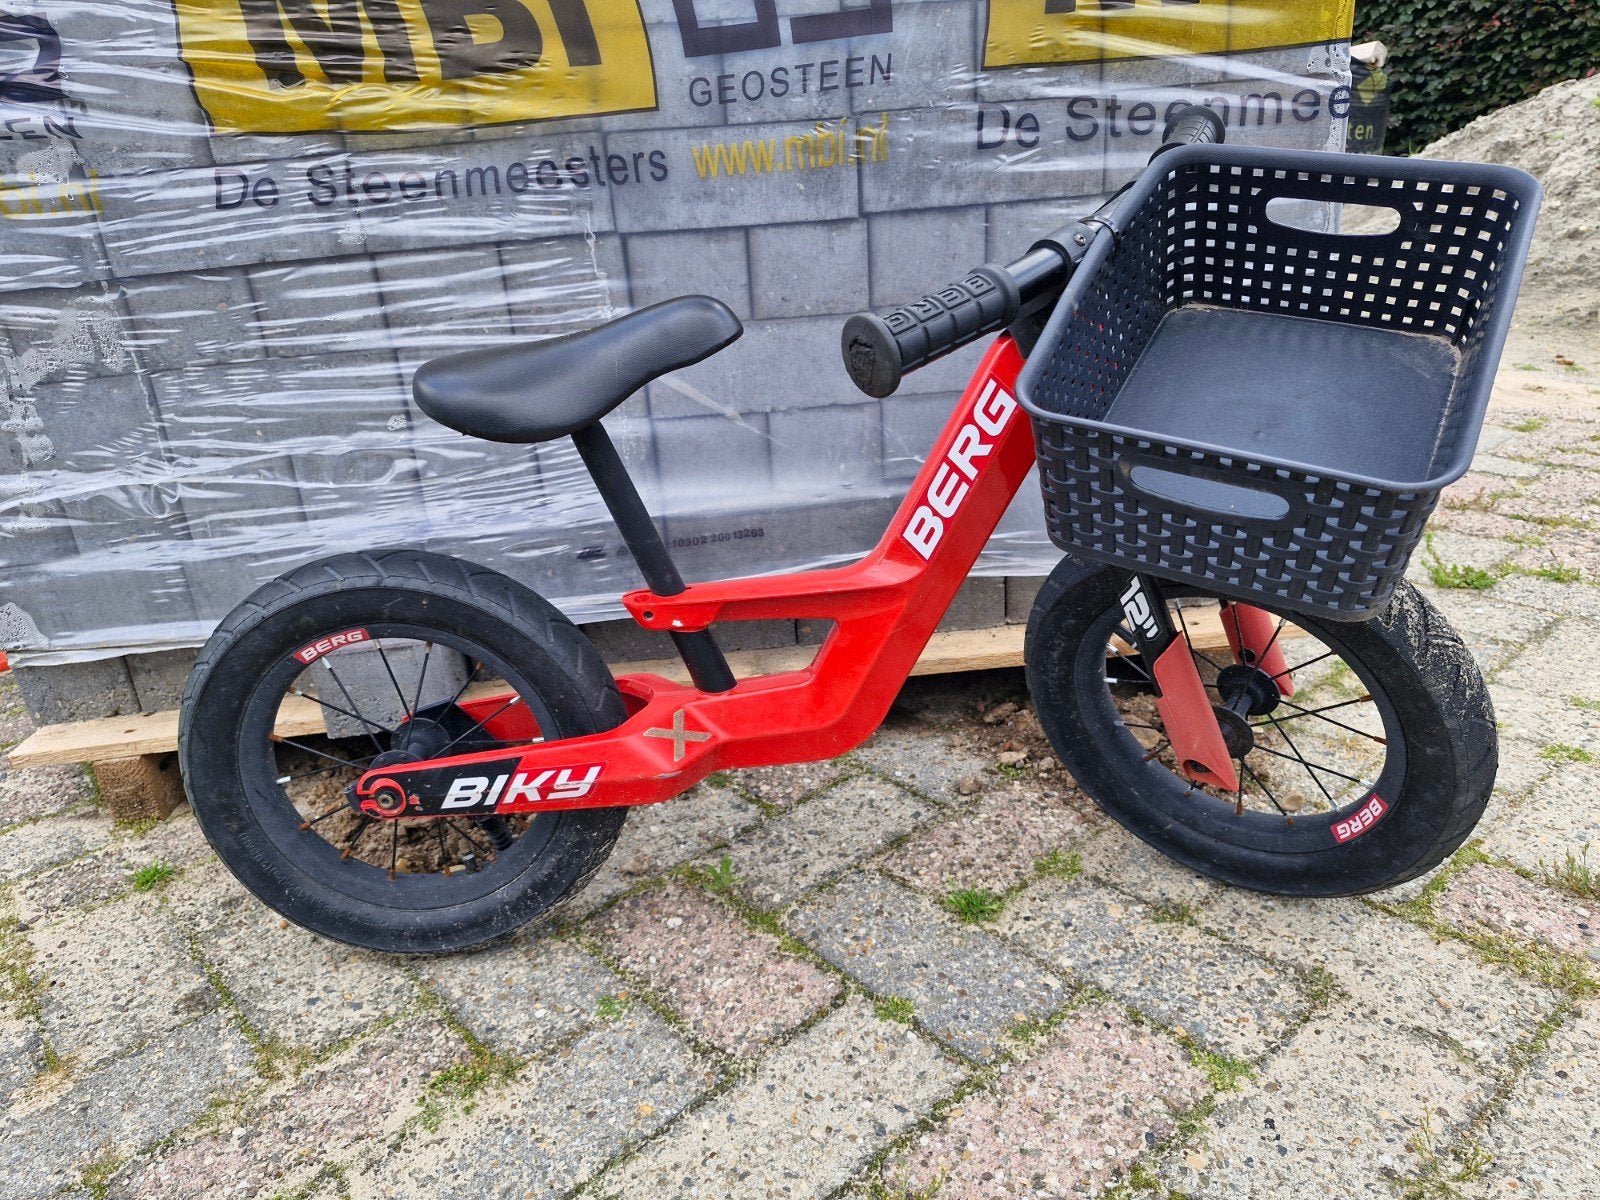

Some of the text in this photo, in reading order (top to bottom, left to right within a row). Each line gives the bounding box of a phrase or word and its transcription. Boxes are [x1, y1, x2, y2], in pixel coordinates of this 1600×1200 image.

[689, 53, 892, 107] GEOSTEEN
[691, 112, 888, 178] www.mbi.nl
[977, 101, 1040, 149] De
[214, 146, 669, 210] De Steenmeesters
[902, 377, 1018, 561] BERG
[300, 630, 364, 662] BERG
[1336, 797, 1383, 840] BERG
